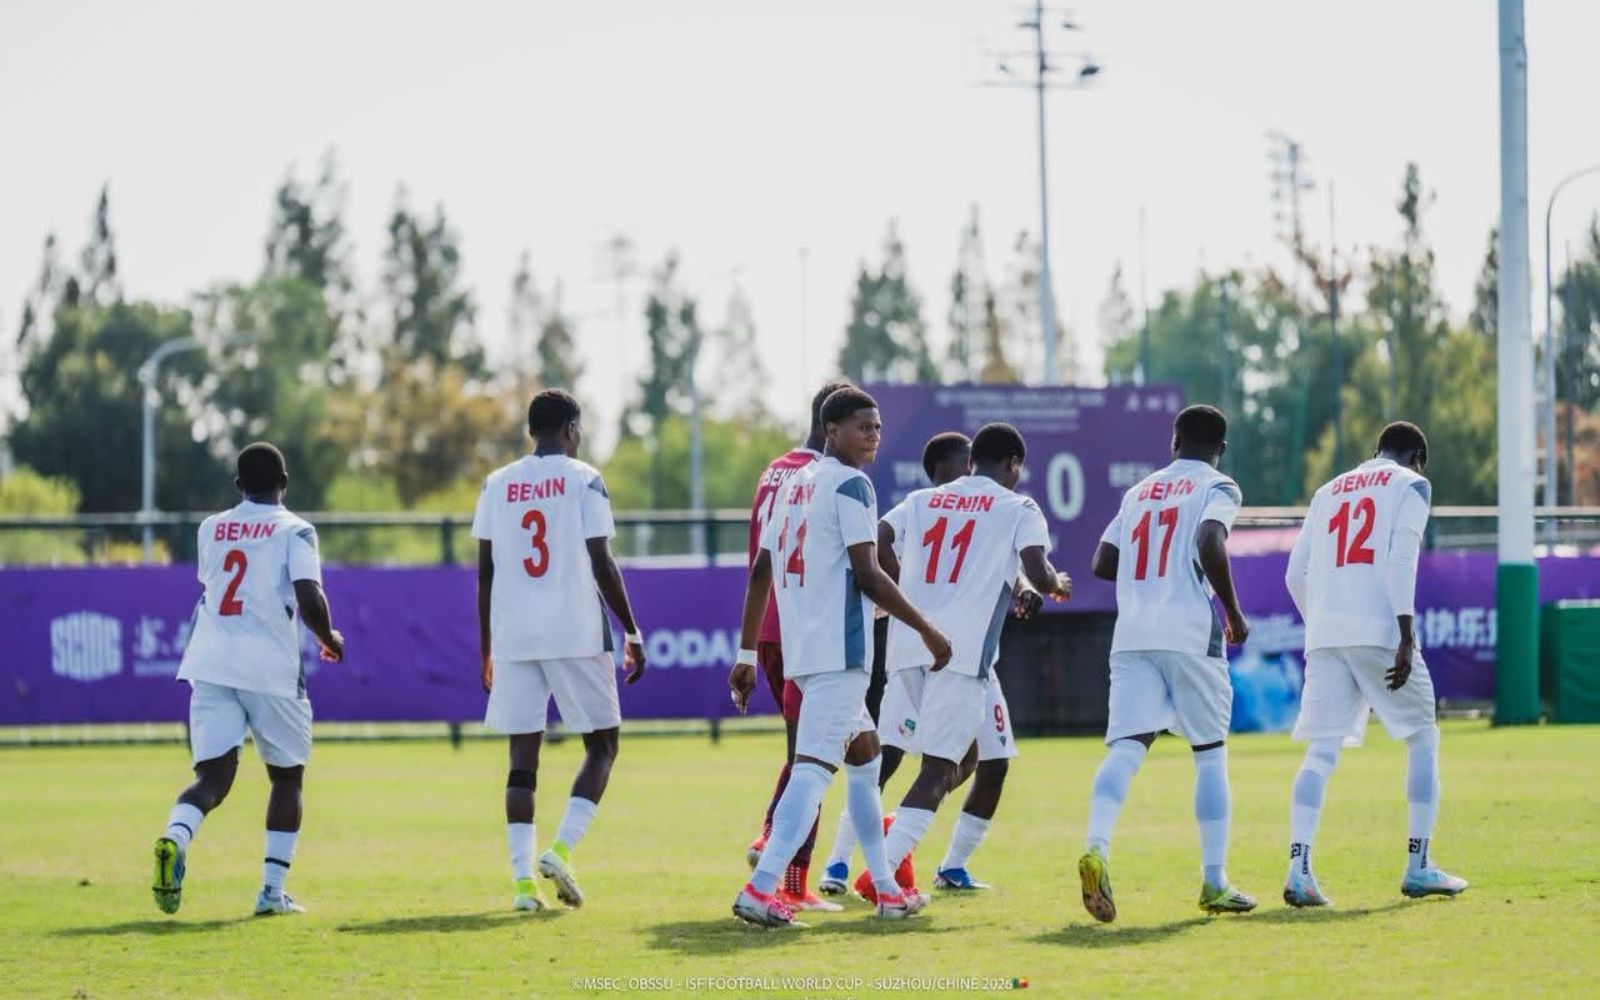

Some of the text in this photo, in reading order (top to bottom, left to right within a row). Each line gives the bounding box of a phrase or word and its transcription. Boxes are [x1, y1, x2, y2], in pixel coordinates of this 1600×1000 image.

[506, 477, 566, 503] BENIN
[927, 493, 995, 513] BENIN
[1046, 452, 1084, 521] 0
[1331, 471, 1393, 496] BENIN
[214, 522, 277, 542] BENIN
[521, 510, 550, 578] 3
[922, 516, 976, 583] 11
[1131, 507, 1179, 580] 17
[1328, 497, 1375, 568] 12
[218, 549, 248, 616] 2
[994, 704, 1004, 732] 9
